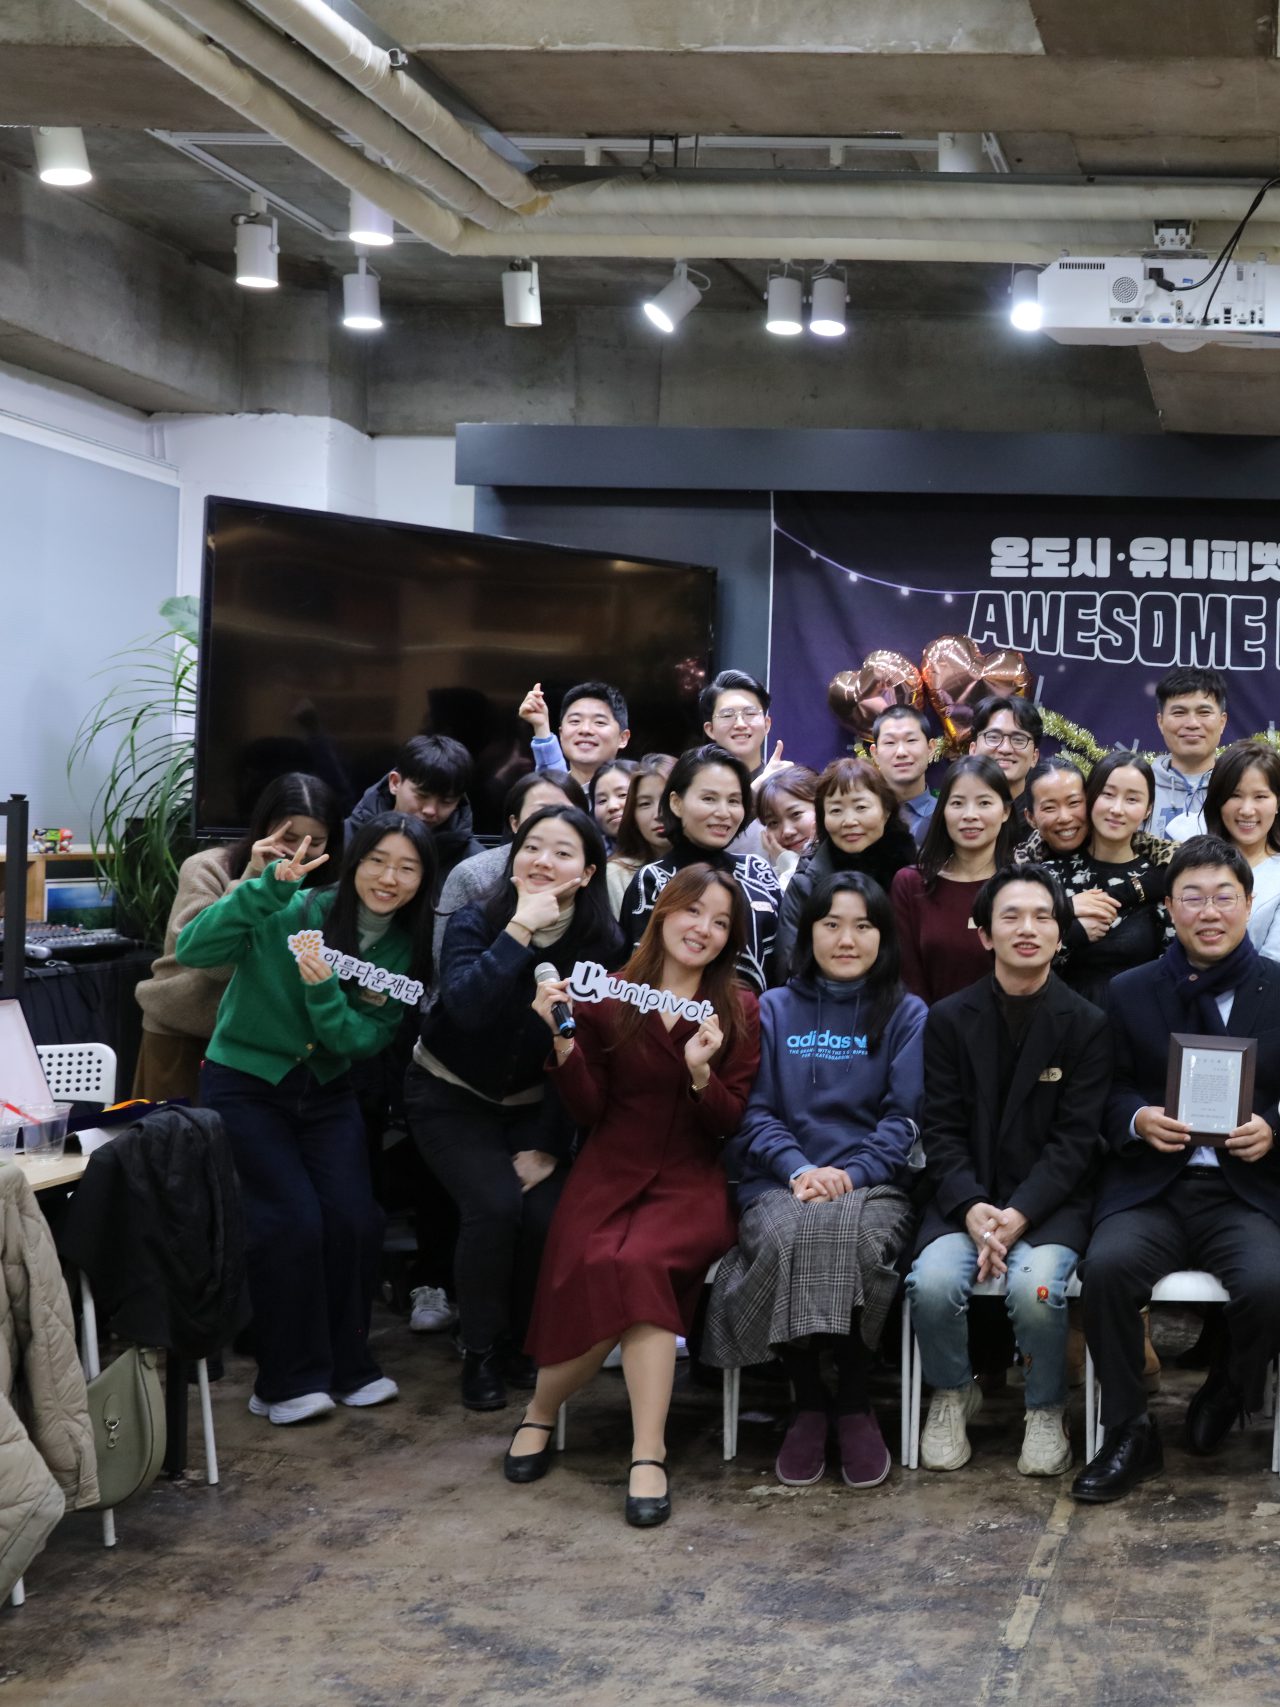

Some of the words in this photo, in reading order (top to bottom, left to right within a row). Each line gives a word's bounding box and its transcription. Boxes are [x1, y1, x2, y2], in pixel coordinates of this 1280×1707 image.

[967, 590, 1267, 671] AWESOME
[323, 951, 421, 1002] 아름다운재단
[608, 978, 714, 1021] unipivot
[787, 1030, 851, 1049] adidas
